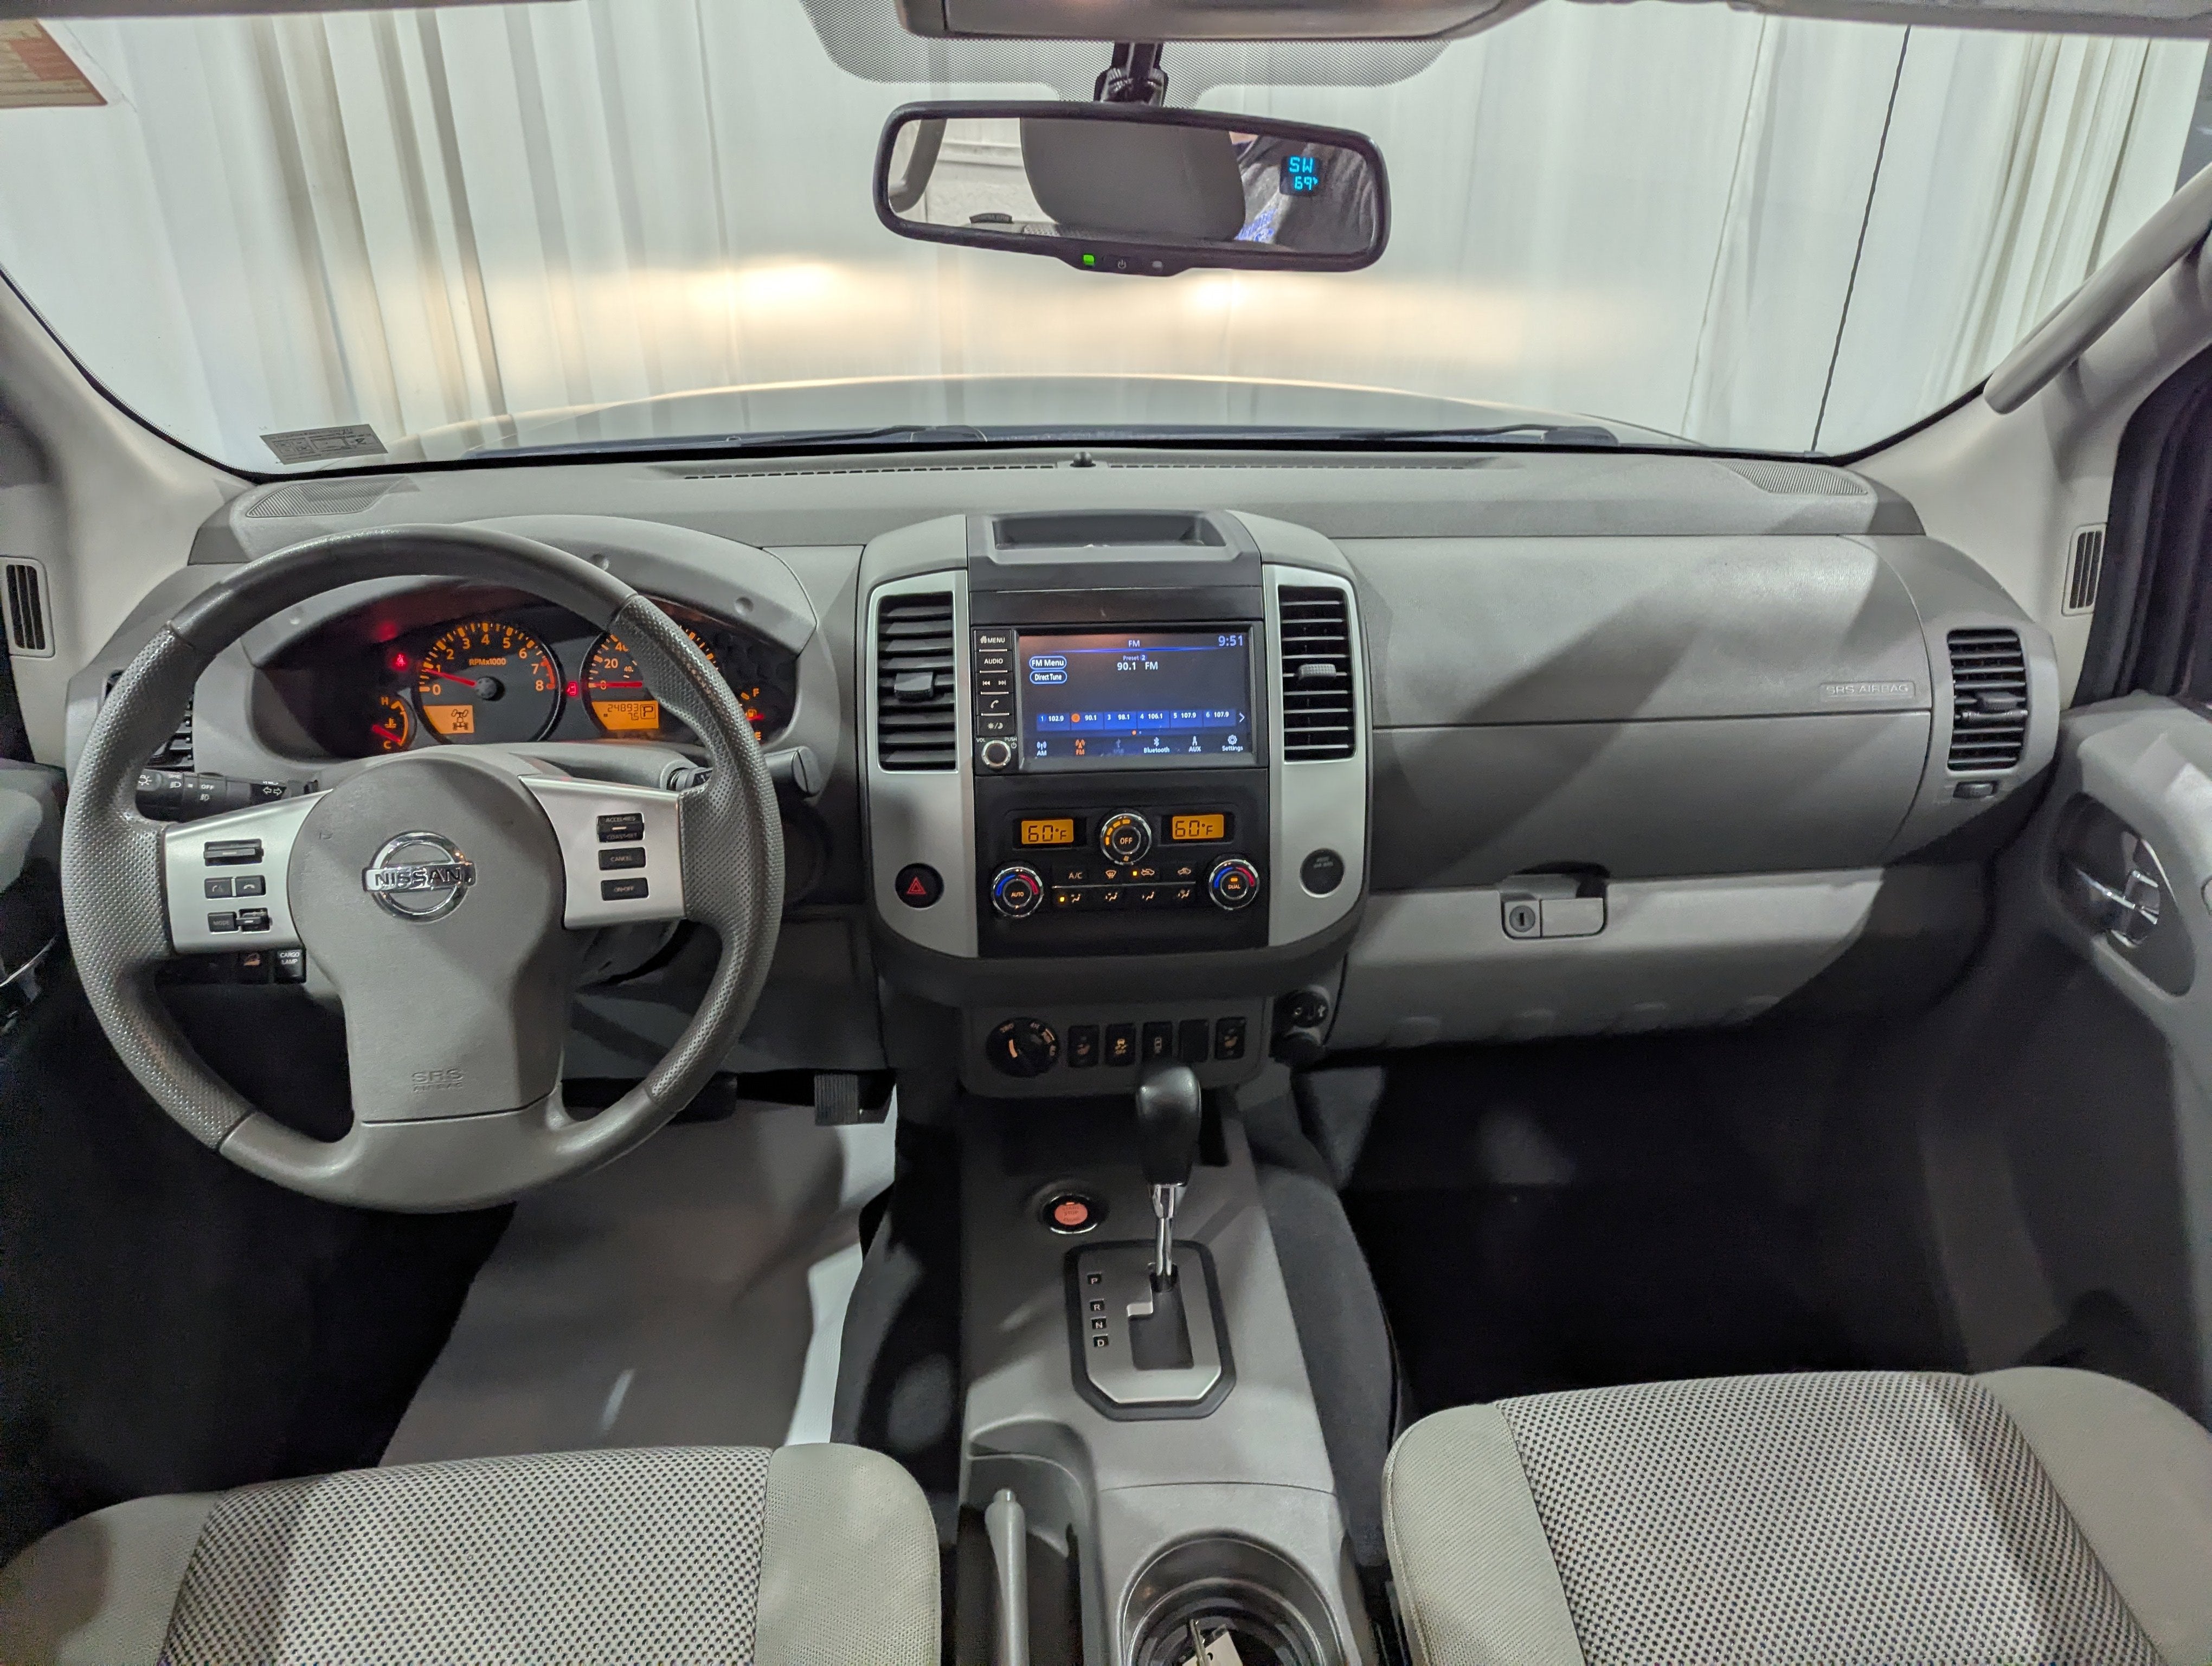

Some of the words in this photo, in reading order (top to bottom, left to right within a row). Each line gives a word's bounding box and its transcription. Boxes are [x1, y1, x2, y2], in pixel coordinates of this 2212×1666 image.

[1289, 157, 1313, 173] SW
[462, 638, 470, 649] 3
[481, 634, 490, 645] 4
[503, 637, 511, 649] 5
[1128, 639, 1140, 648] FM
[1218, 635, 1243, 646] 9:51
[446, 649, 454, 660] 2
[519, 648, 527, 659] 6
[436, 664, 441, 673] 1
[531, 663, 539, 675] 7
[604, 658, 619, 669] 20
[1117, 662, 1136, 671] 90.1
[1144, 661, 1158, 670] FM
[432, 683, 442, 696] 0
[535, 680, 544, 691] 8
[1827, 685, 1854, 694] SRS
[1859, 684, 1908, 694] AIRBAG
[753, 688, 760, 697] F
[381, 697, 389, 706] H
[607, 703, 639, 713] 24893
[642, 706, 654, 717] P
[755, 732, 761, 741] E
[383, 740, 391, 749] C
[375, 868, 461, 887] NISSAN
